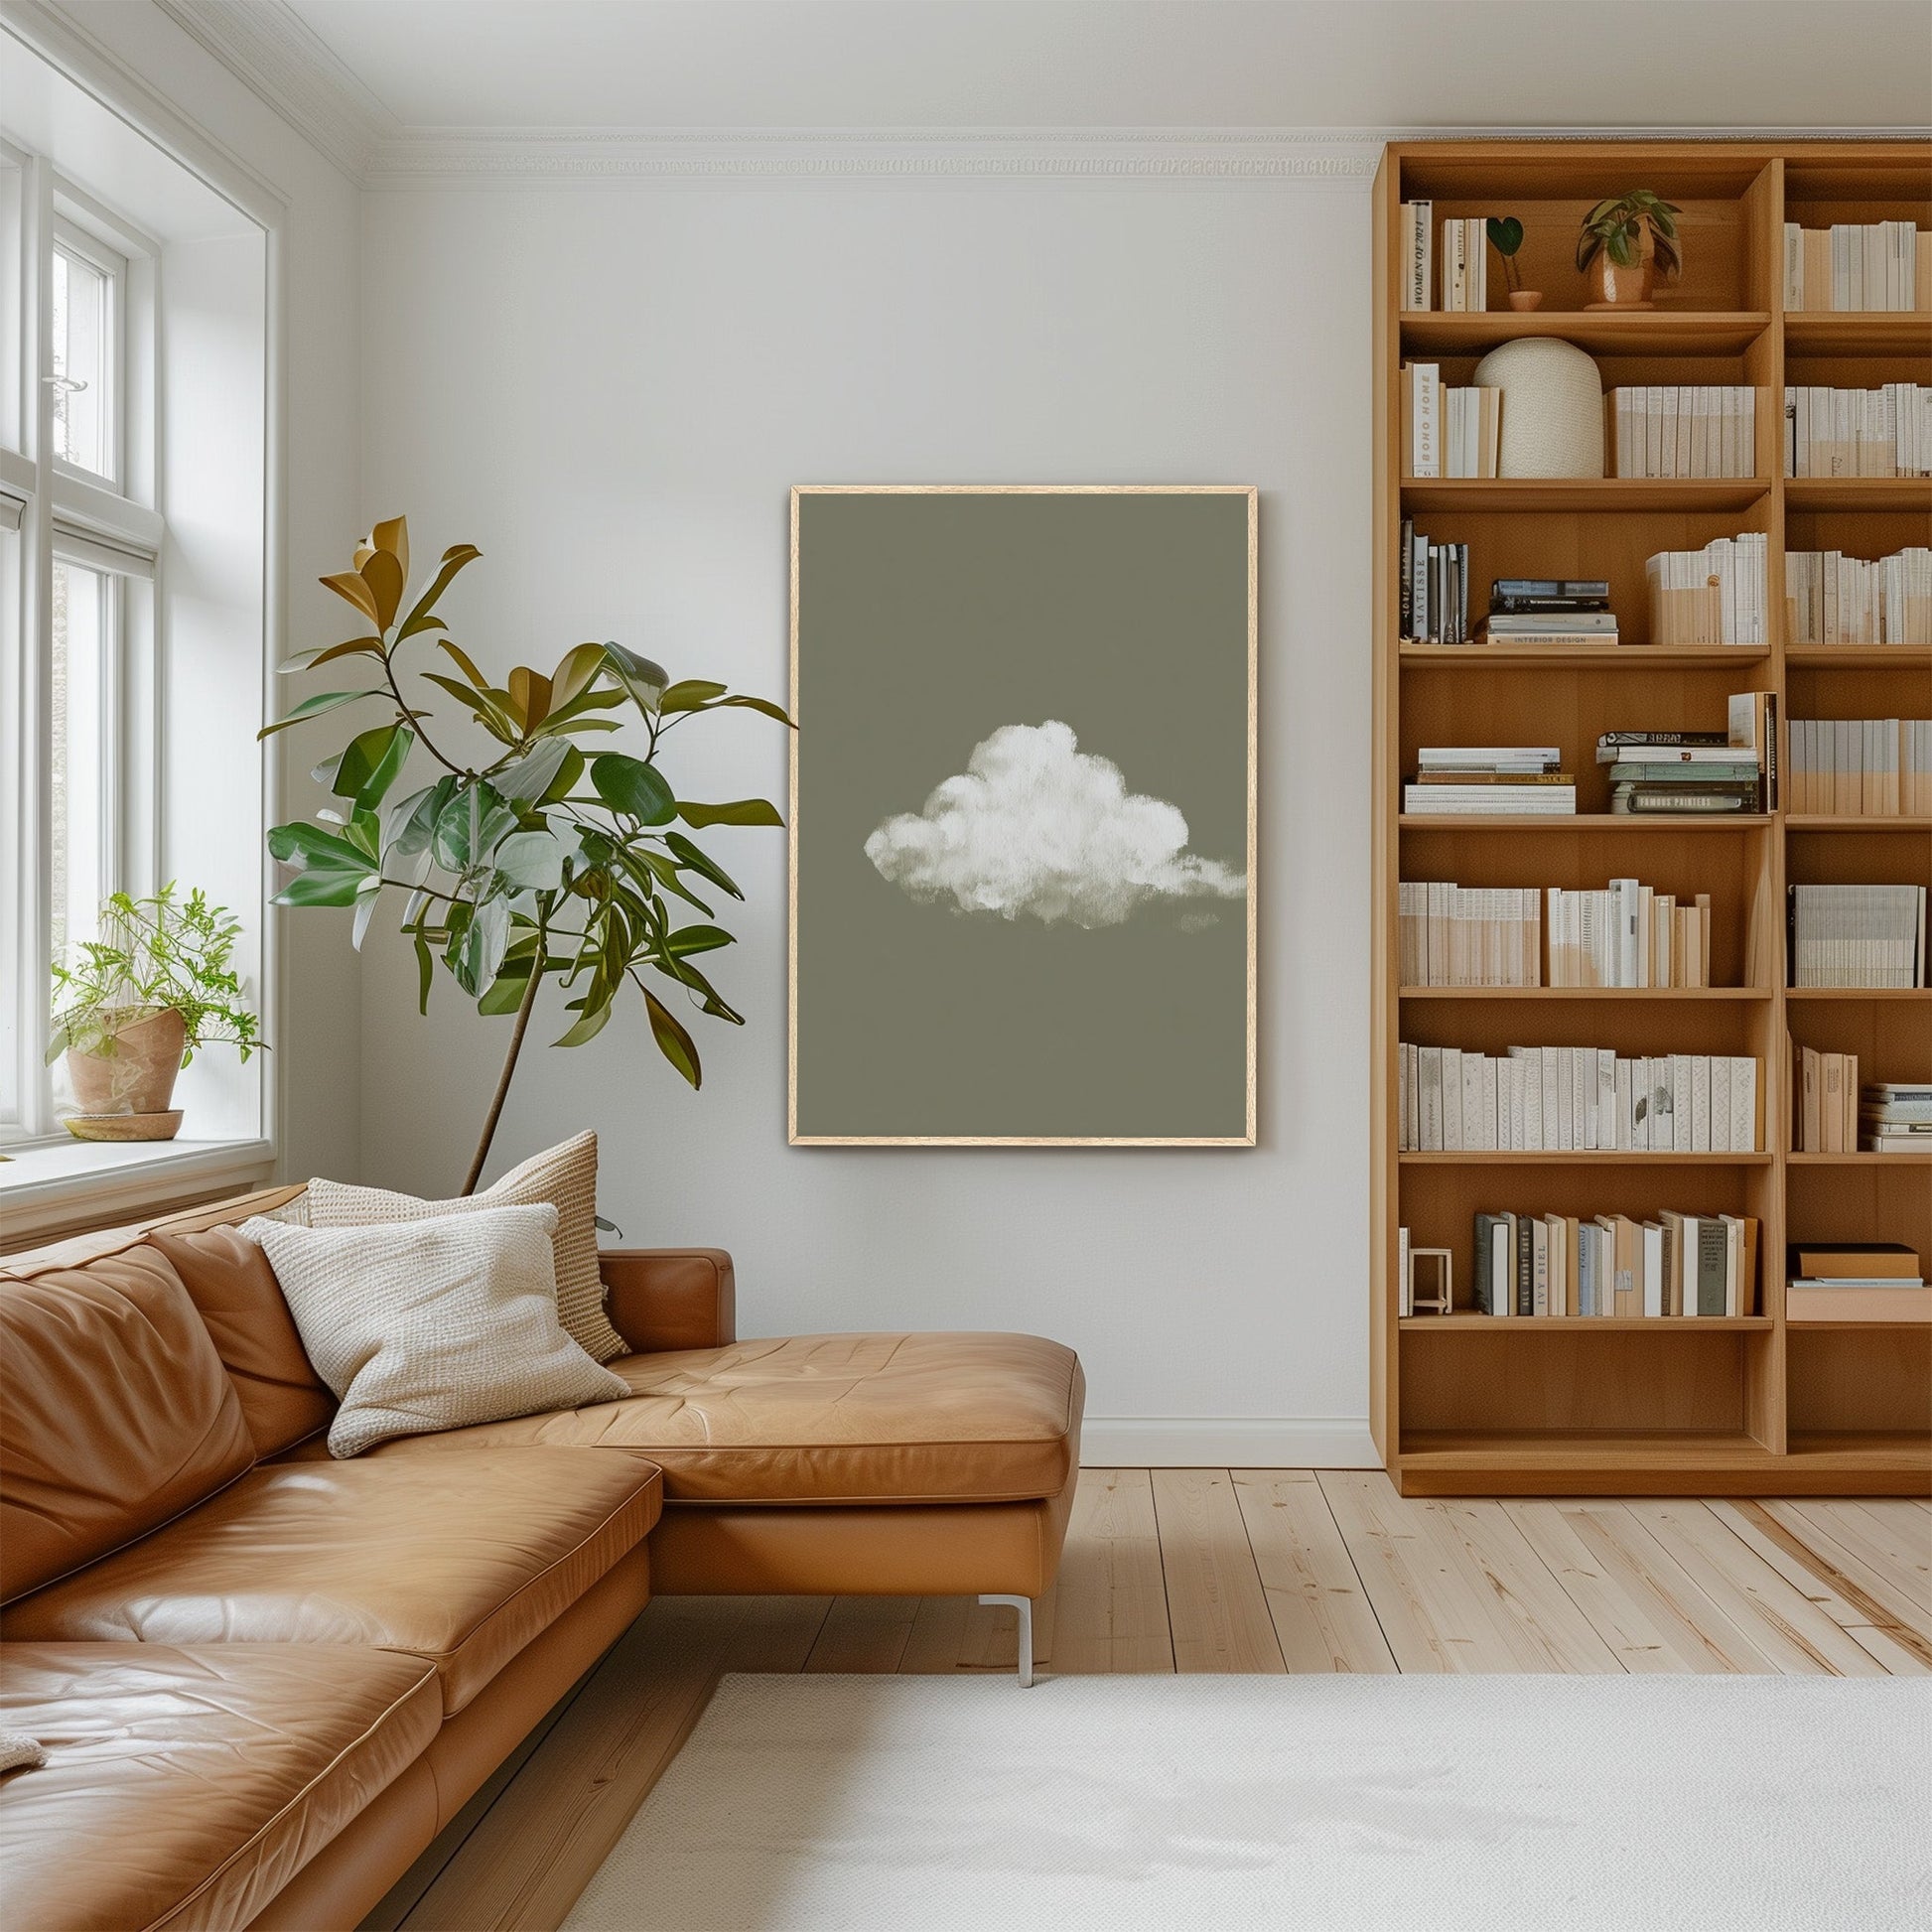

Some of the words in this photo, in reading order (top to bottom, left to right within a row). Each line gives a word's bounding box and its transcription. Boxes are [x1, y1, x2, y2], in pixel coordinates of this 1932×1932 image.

[1415, 244, 1425, 260] OF
[1414, 262, 1424, 306] WOMEN
[1422, 374, 1431, 415] HOME
[1422, 422, 1431, 462] BOHO
[1416, 559, 1426, 624] MATISSE
[1639, 797, 1672, 807] FAMOUS
